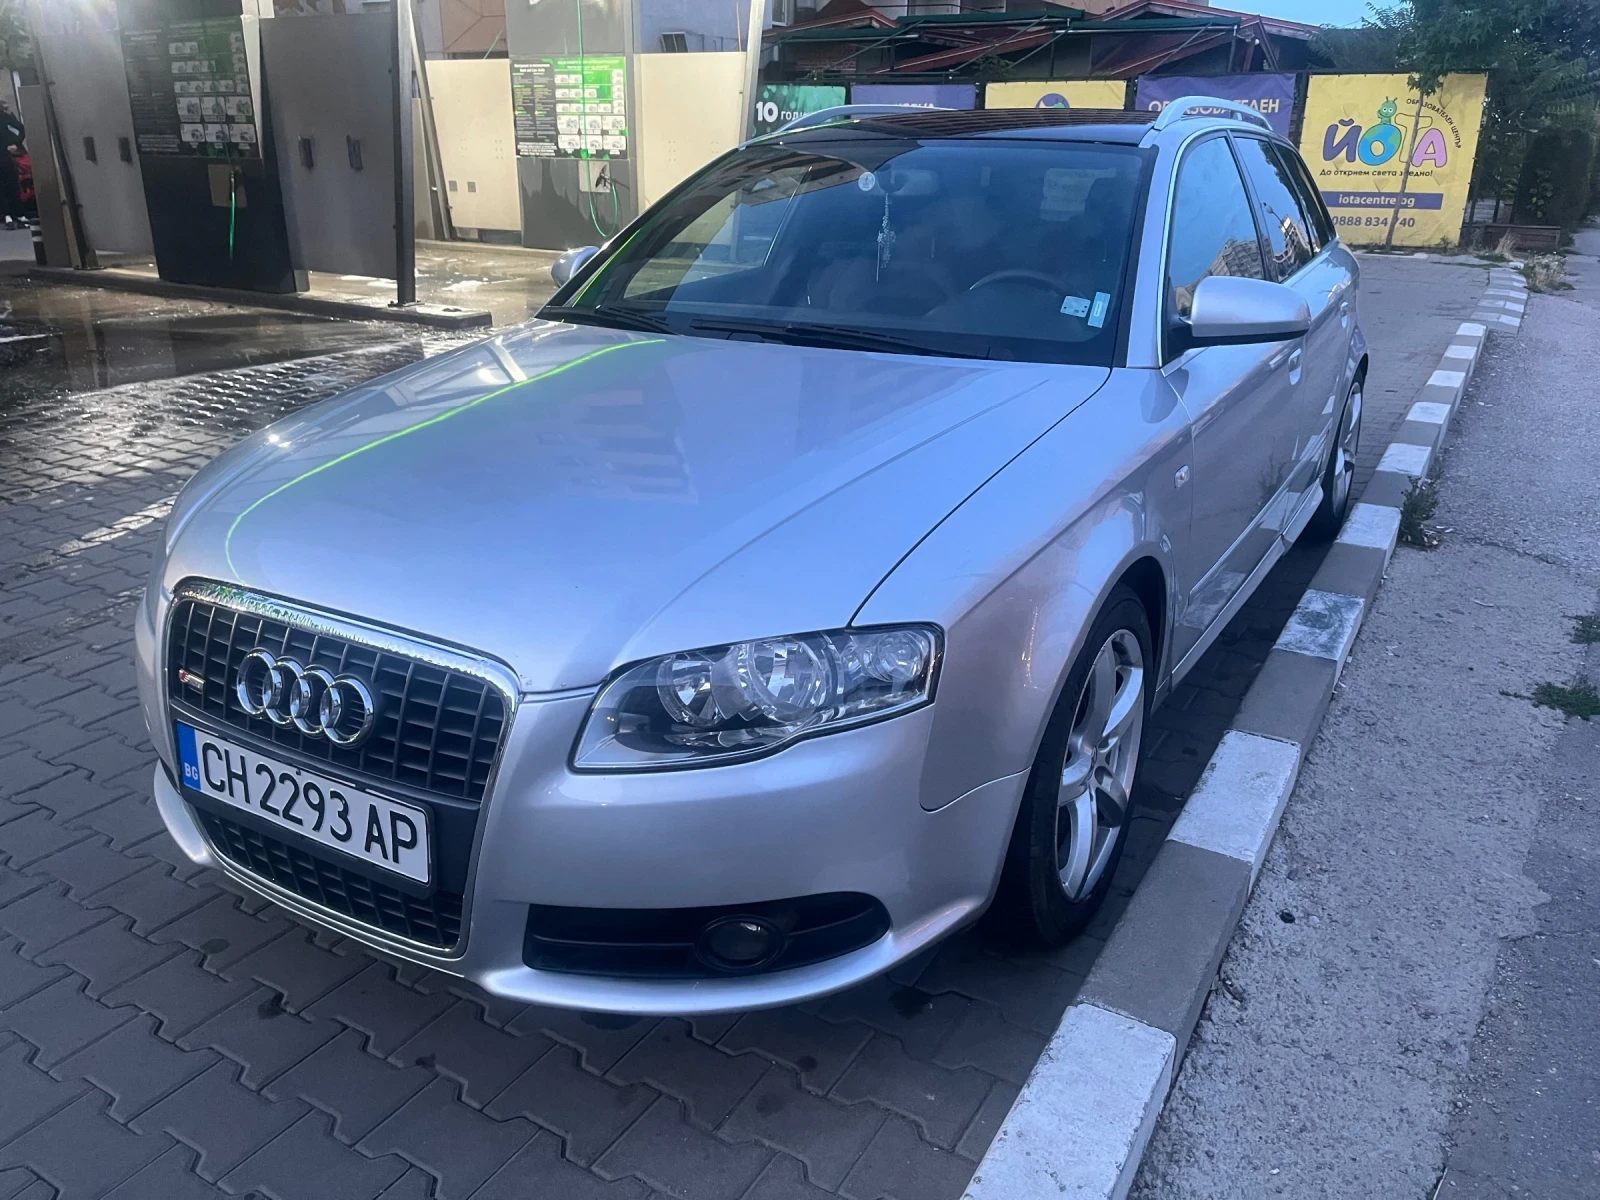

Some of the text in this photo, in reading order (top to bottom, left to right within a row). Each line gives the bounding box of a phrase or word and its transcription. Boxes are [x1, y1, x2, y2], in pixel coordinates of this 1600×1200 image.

[756, 101, 779, 123] 10
[1406, 98, 1462, 149] ОБРЗОВАТЕЛЕН ЦЕНТЪР
[1322, 113, 1448, 168] ЙОТА
[1333, 169, 1370, 177] открием
[1398, 169, 1434, 177] зедно!
[1332, 216, 1416, 227] 0888 834 40
[185, 740, 419, 865] BG CH 2293 AP
